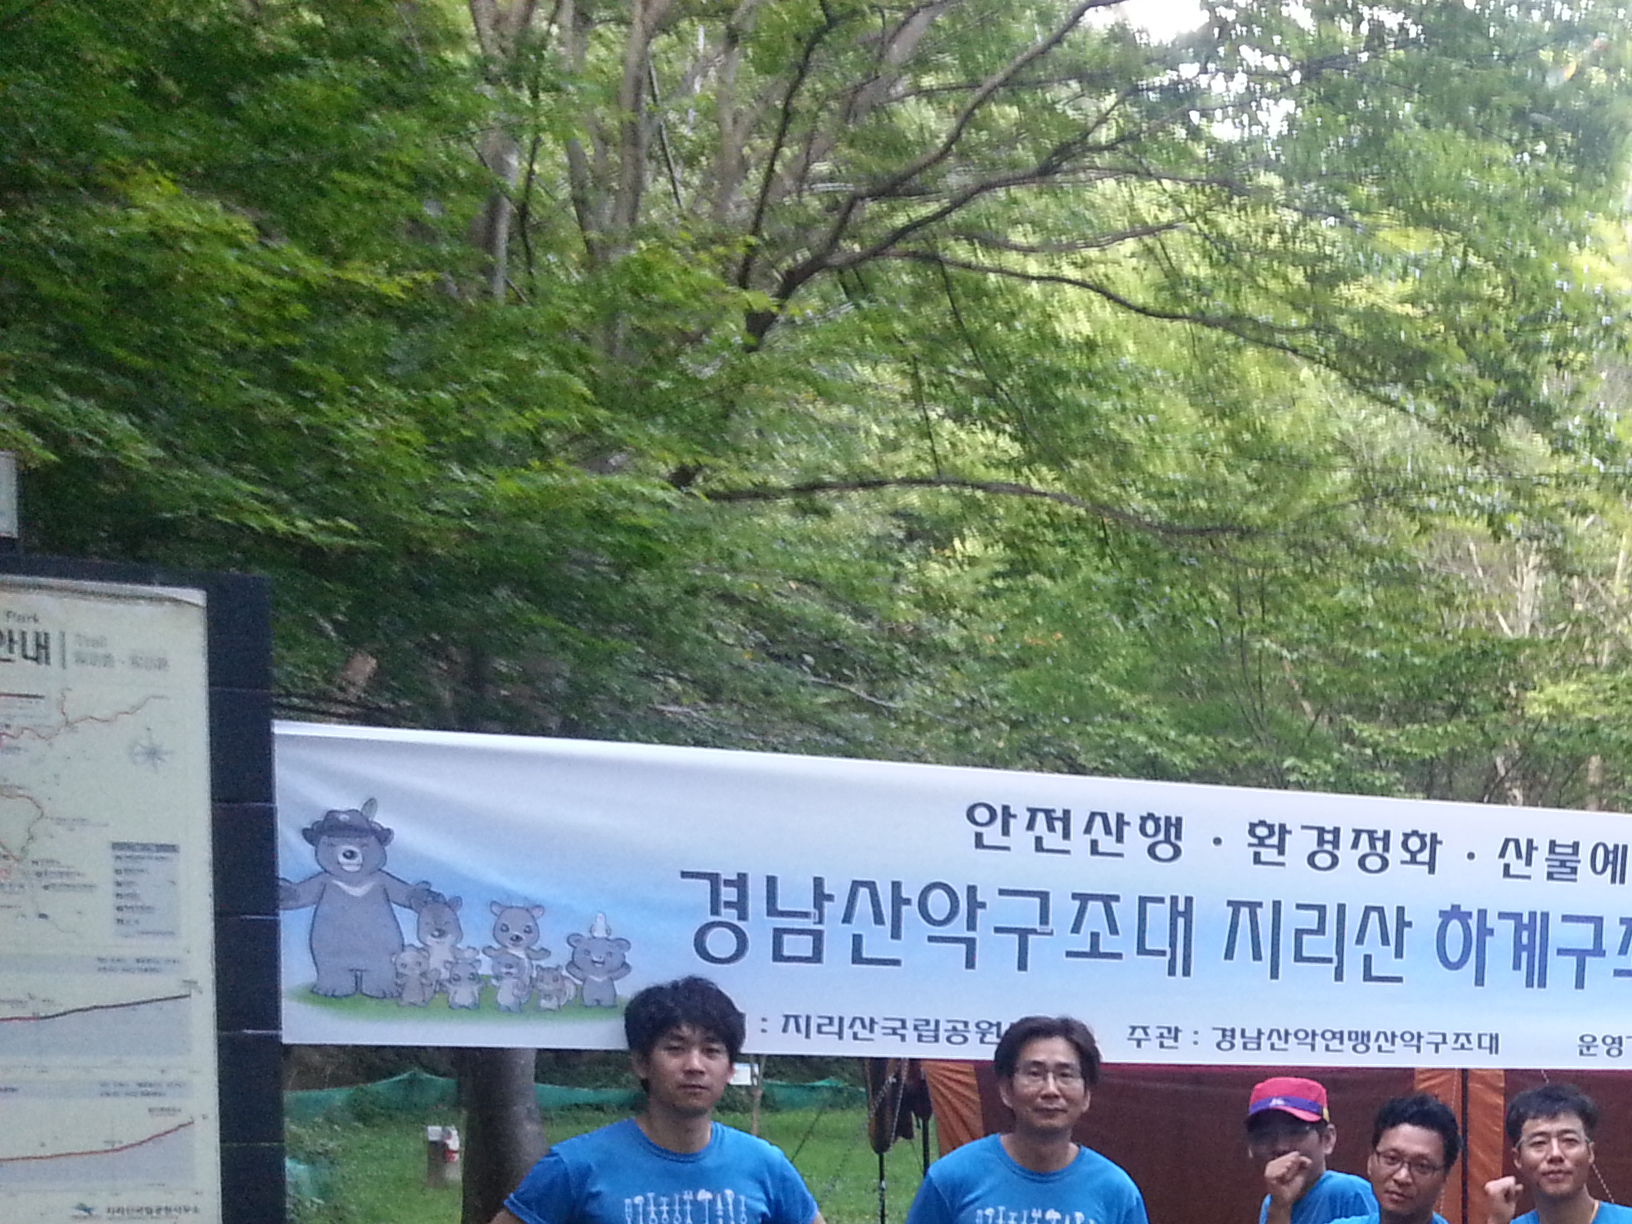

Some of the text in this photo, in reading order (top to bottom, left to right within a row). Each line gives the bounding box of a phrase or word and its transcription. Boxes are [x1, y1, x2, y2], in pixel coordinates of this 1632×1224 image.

[966, 802, 1183, 863] 안전산행
[1247, 819, 1443, 875] 환경정화
[680, 870, 1194, 978] 경남산악구조대
[1223, 899, 1413, 983] 지리산
[1127, 1025, 1182, 1050] 주관
[1211, 1026, 1500, 1056] 경남산악연맹산악구조대
